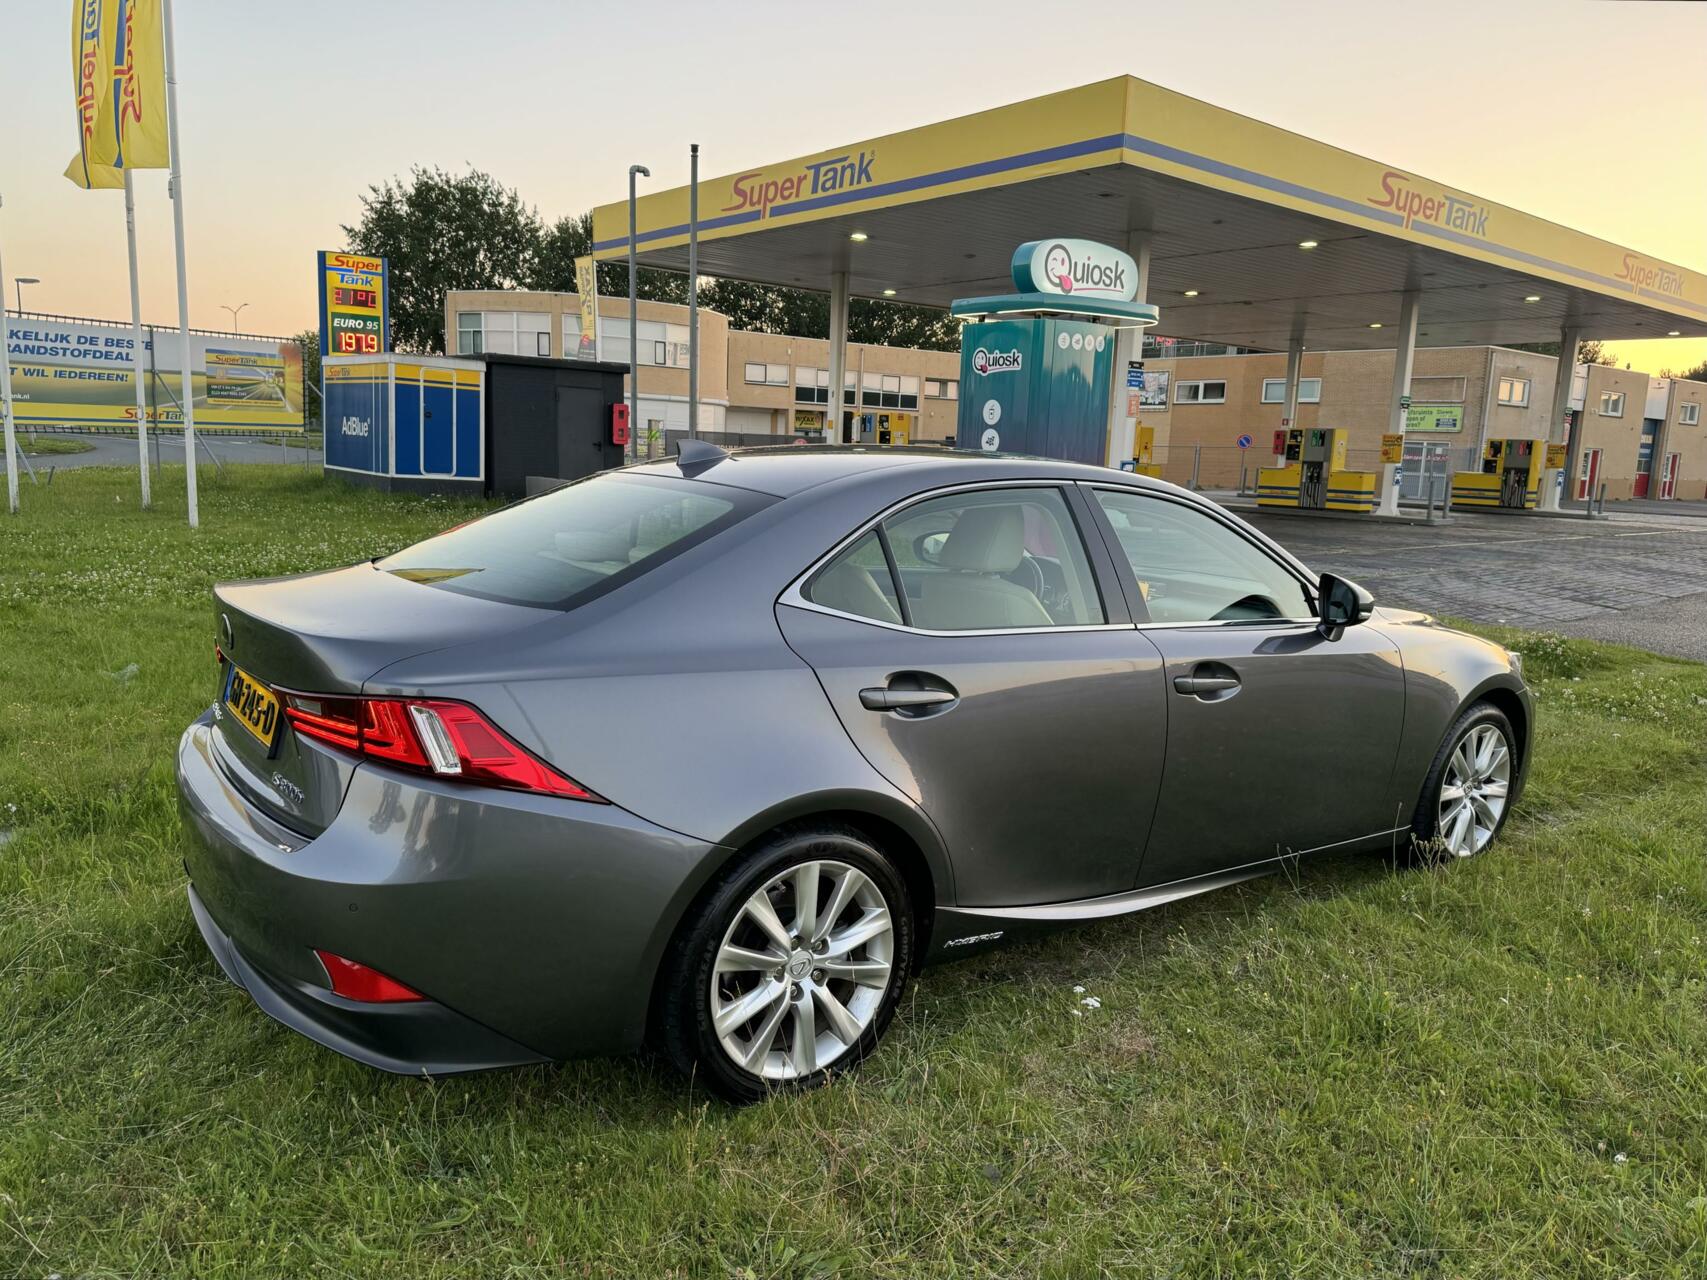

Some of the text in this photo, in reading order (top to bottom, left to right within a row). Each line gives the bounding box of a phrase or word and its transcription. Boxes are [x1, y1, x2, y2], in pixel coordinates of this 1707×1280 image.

[721, 152, 875, 220] SuperTank
[1367, 171, 1488, 236] SuperTank
[326, 255, 382, 273] Super
[1045, 244, 1125, 291] Quiosk
[1614, 252, 1684, 296] SuperTank
[336, 272, 373, 287] Tank
[333, 318, 379, 330] EURO 95
[8, 329, 152, 350] KELIJK DE BESE
[340, 332, 377, 352] 197.9
[974, 350, 1020, 373] Quiosk
[22, 367, 49, 378] WIL
[54, 370, 128, 382] IEDEREEN!
[341, 416, 369, 437] AdBlue
